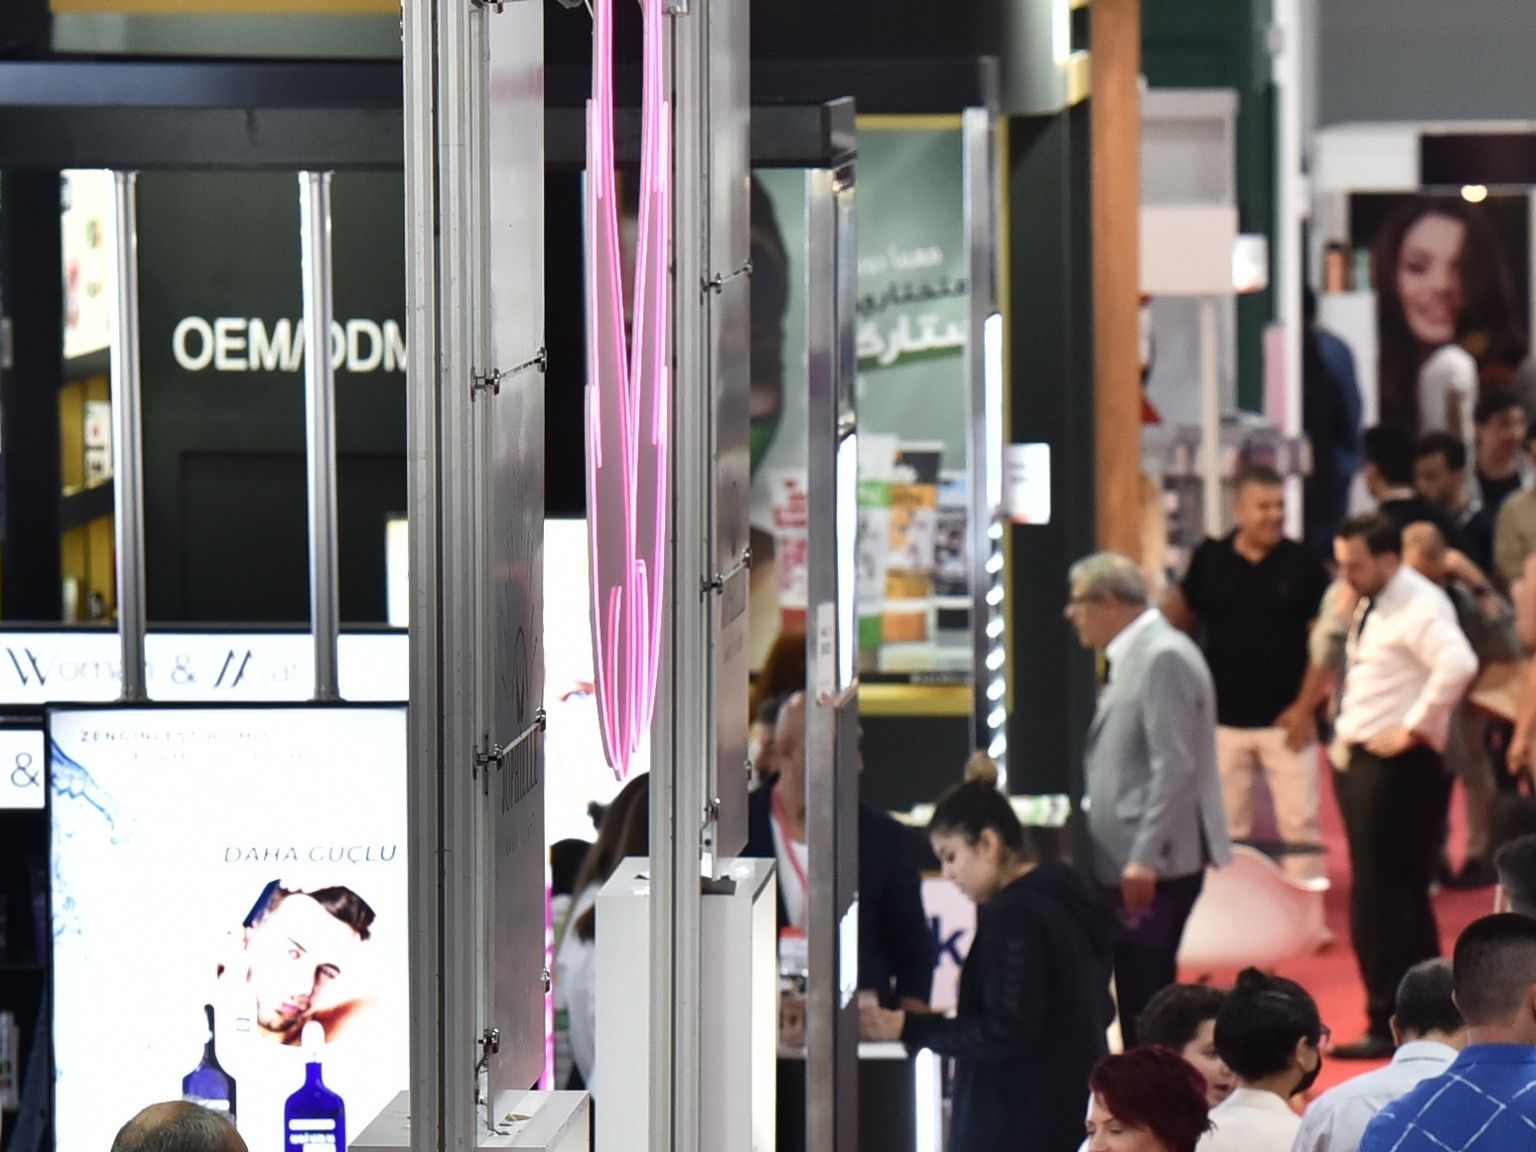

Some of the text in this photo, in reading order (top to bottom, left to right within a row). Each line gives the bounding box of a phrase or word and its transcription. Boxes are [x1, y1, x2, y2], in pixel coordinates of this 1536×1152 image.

[170, 654, 198, 686] &
[10, 751, 41, 788] &
[224, 845, 299, 864] DAHA
